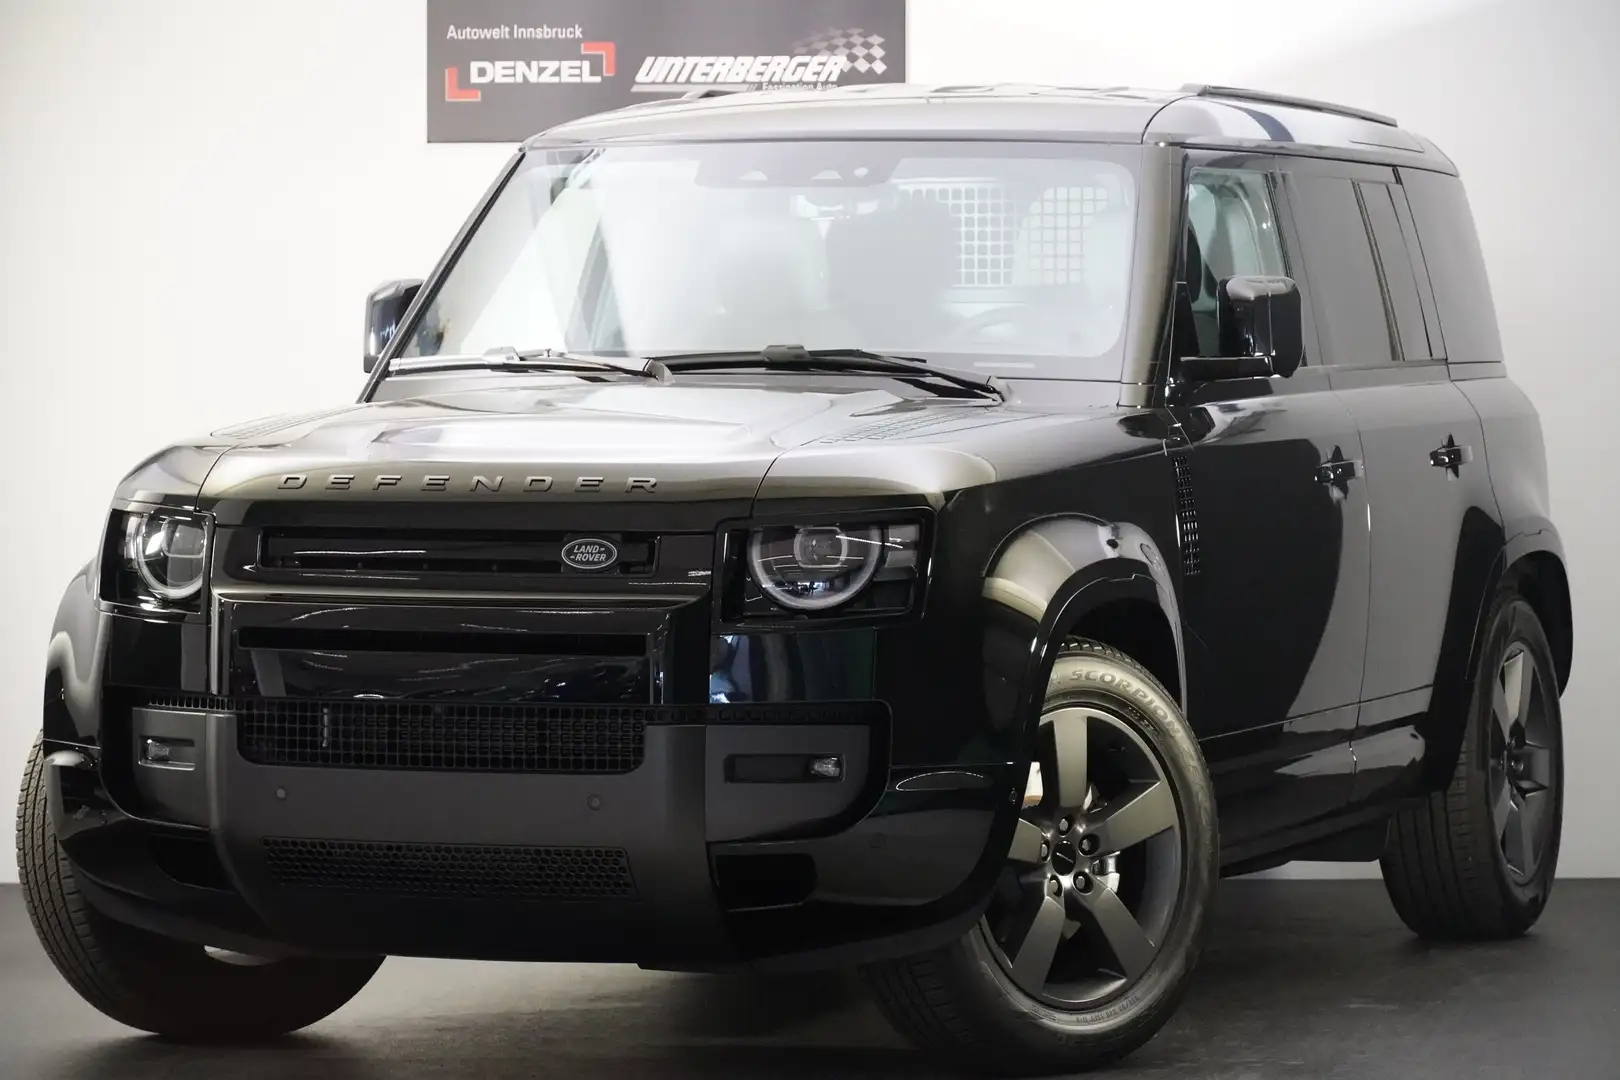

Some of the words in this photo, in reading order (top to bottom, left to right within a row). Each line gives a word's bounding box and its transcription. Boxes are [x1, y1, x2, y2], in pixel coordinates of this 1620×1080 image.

[446, 24, 510, 40] Autowelt
[513, 24, 583, 40] Innsbruck
[469, 60, 602, 84] DENZEL
[634, 55, 848, 83] UNTERBERGER
[276, 474, 659, 494] DEFENDER
[1070, 668, 1180, 739] SCORPION
